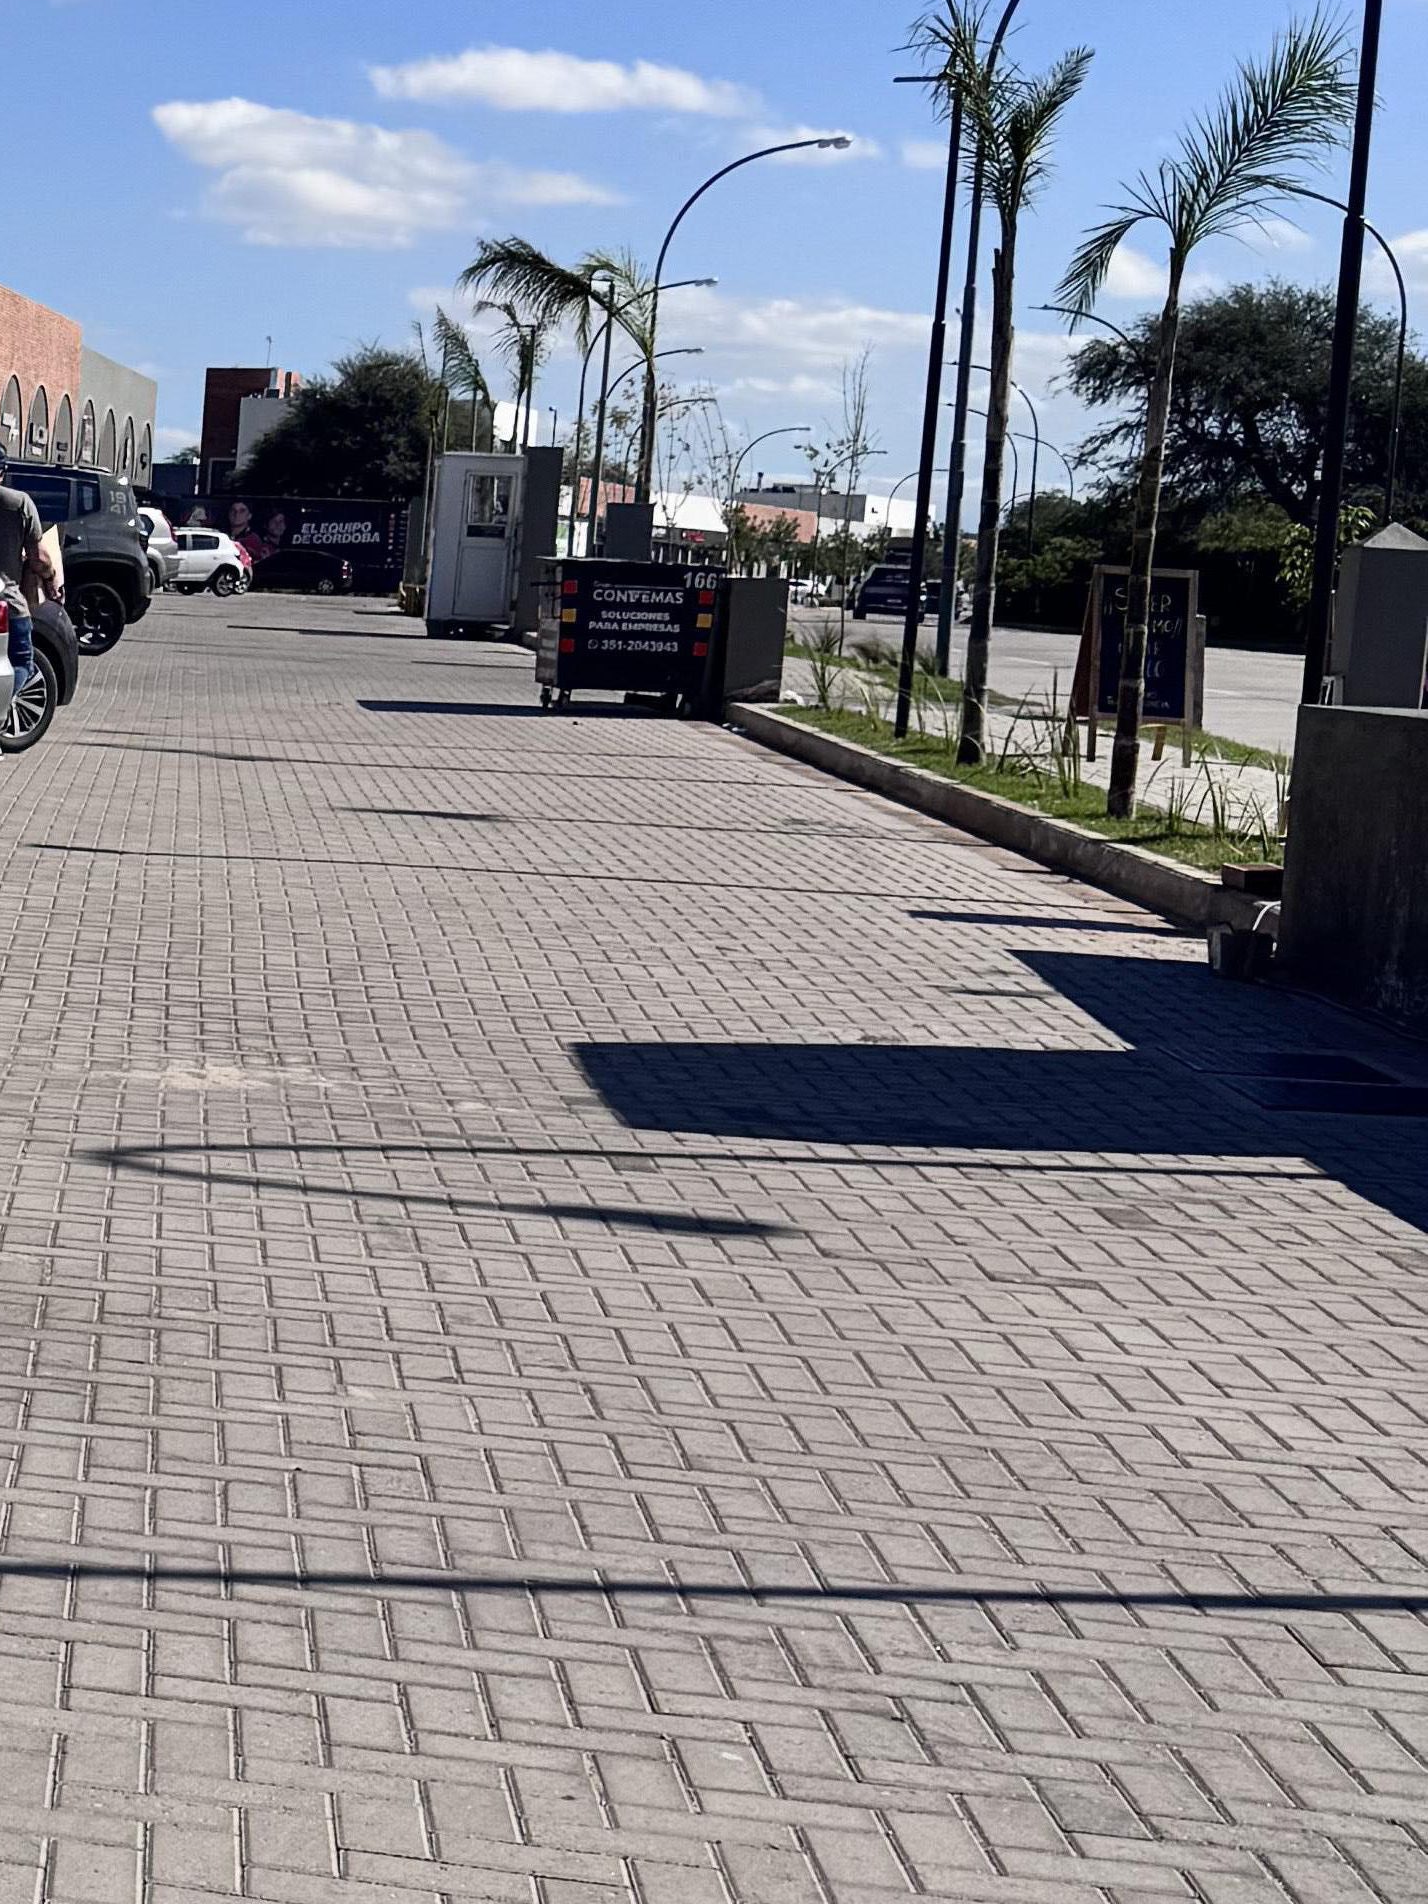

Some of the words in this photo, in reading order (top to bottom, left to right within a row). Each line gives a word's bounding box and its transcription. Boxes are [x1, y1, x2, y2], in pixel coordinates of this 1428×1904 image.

[301, 523, 318, 534] EL
[319, 521, 372, 534] EQUIPO
[291, 534, 311, 545] DE
[600, 610, 671, 621] SOLUCIONES
[588, 621, 619, 630] PARA
[621, 622, 681, 633] EMPRESAS
